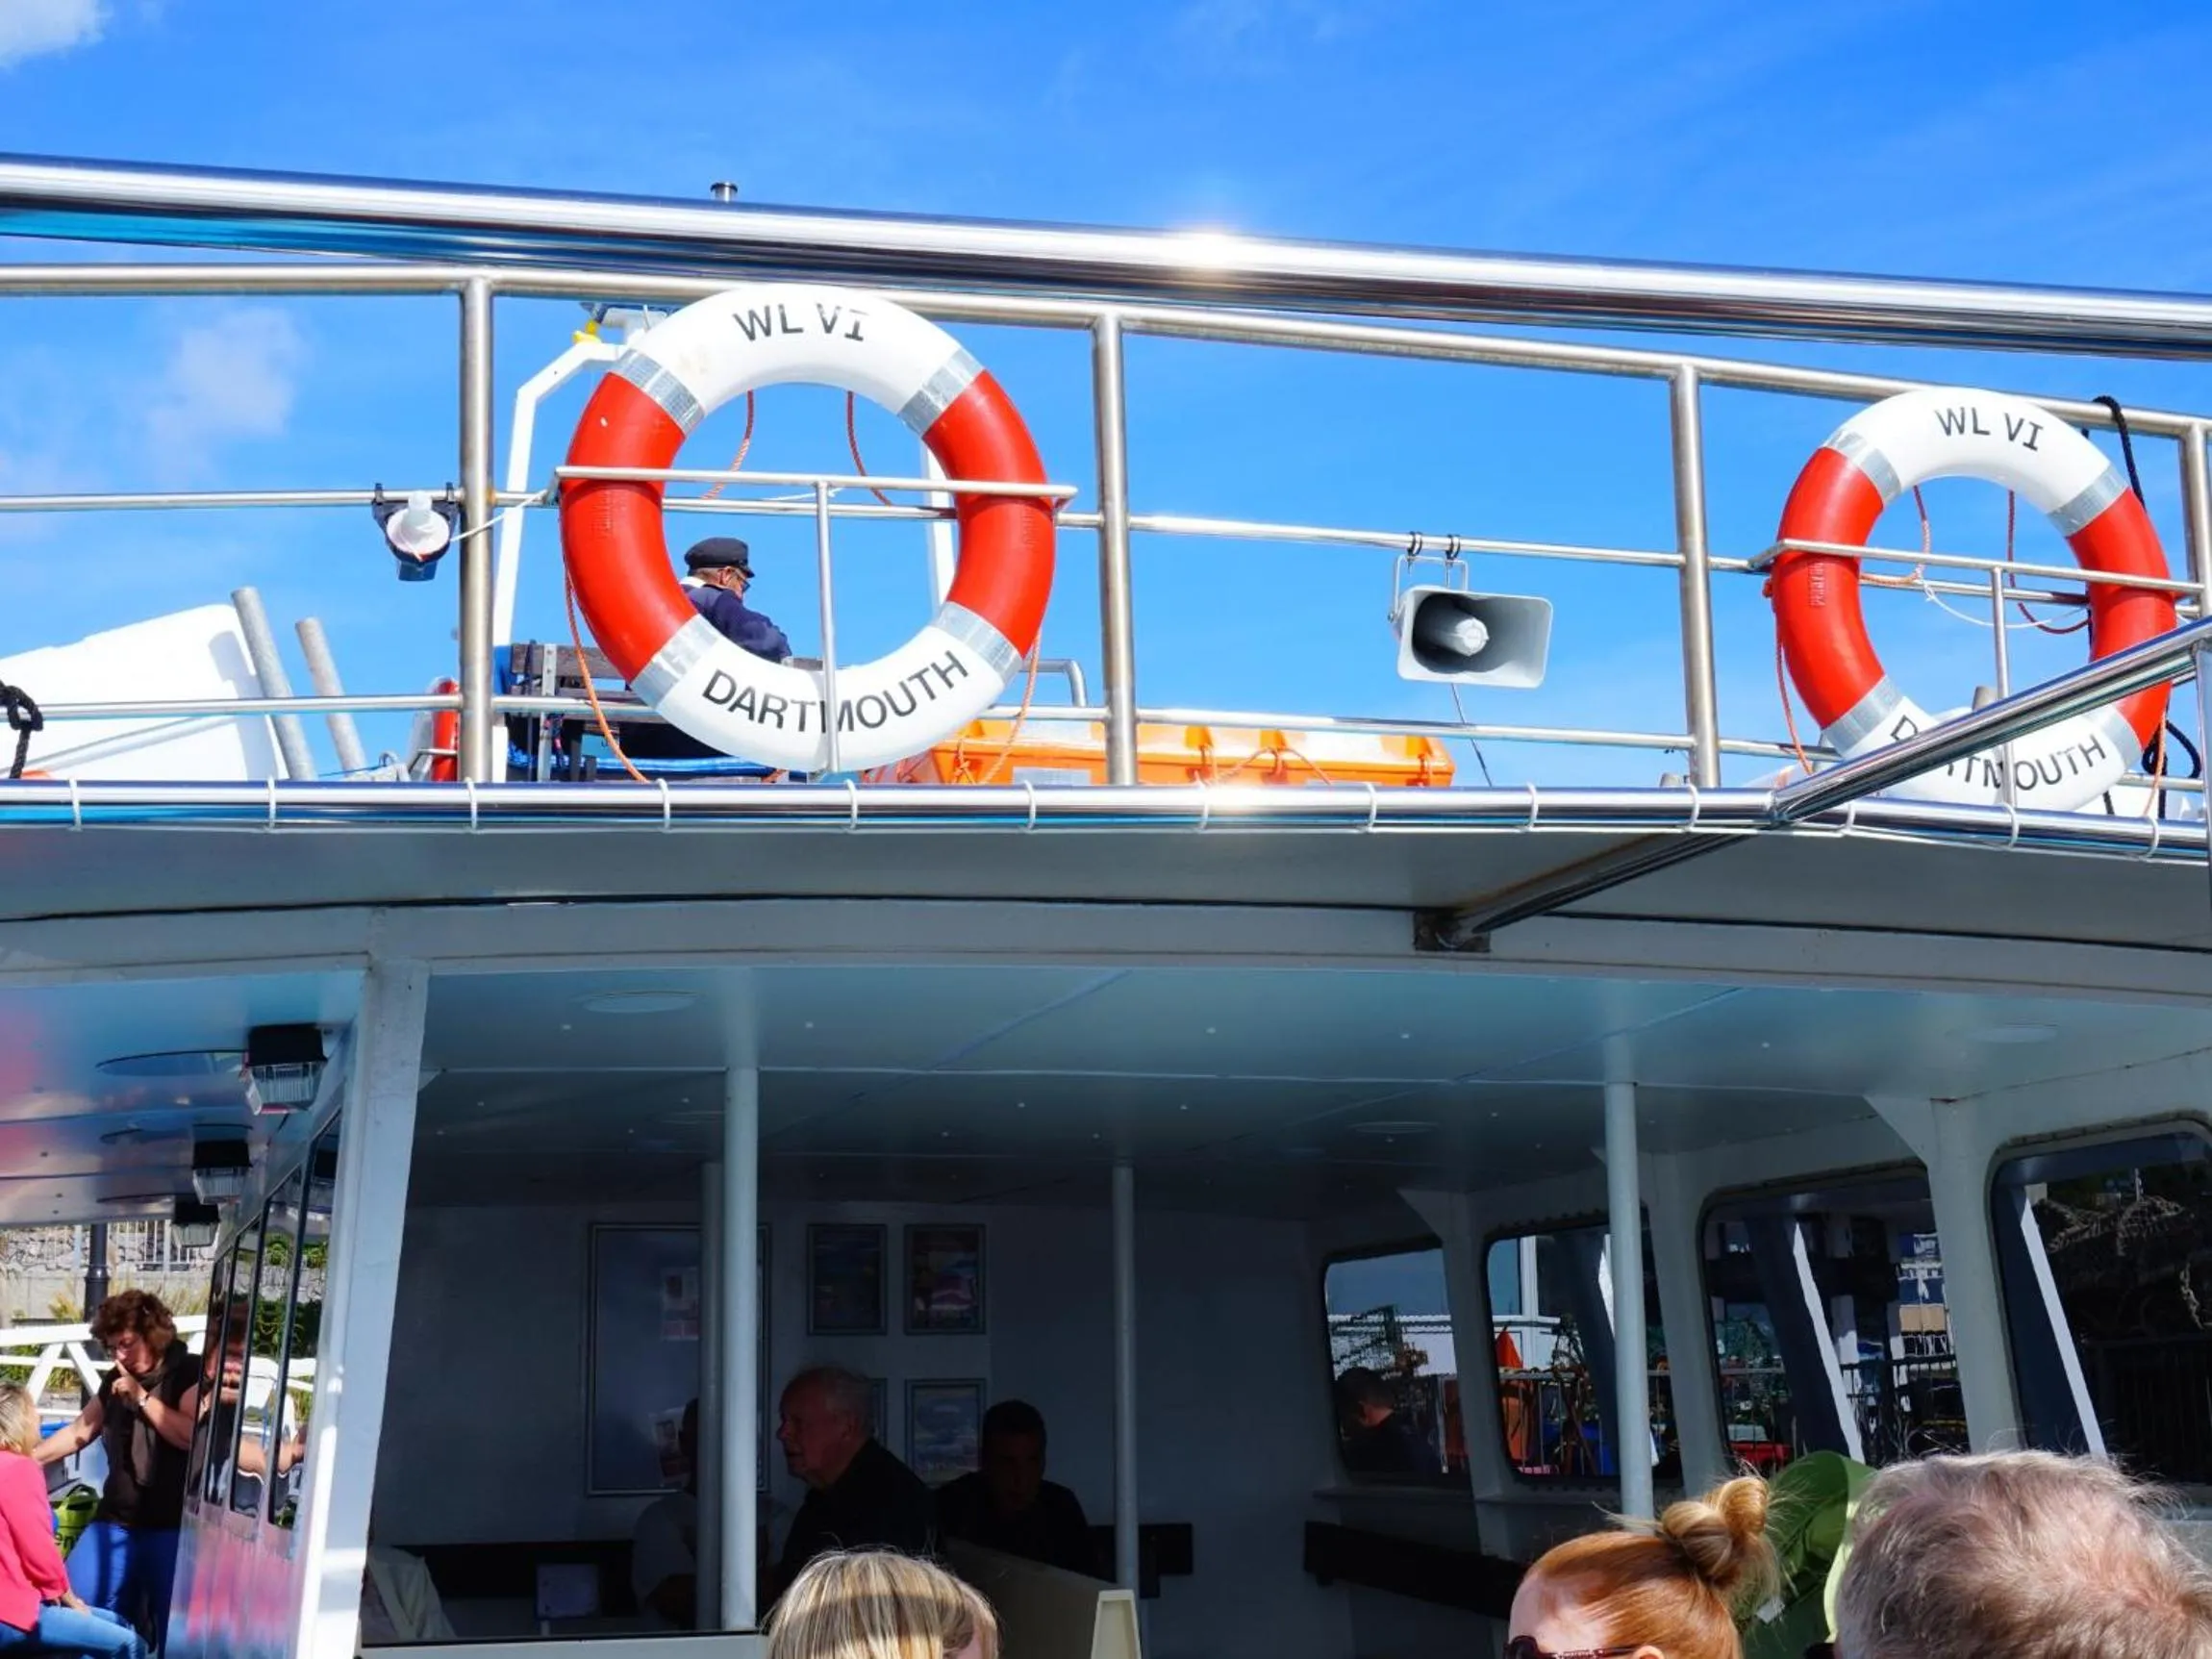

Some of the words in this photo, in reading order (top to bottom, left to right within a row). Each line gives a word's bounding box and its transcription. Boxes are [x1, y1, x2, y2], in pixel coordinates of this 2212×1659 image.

[732, 304, 804, 341] WL
[815, 302, 870, 342] VI
[1934, 406, 1992, 438] WL
[2003, 412, 2045, 452] VI
[701, 649, 969, 734] DARTMOUTH
[1890, 714, 2107, 791] DTMOUTH
